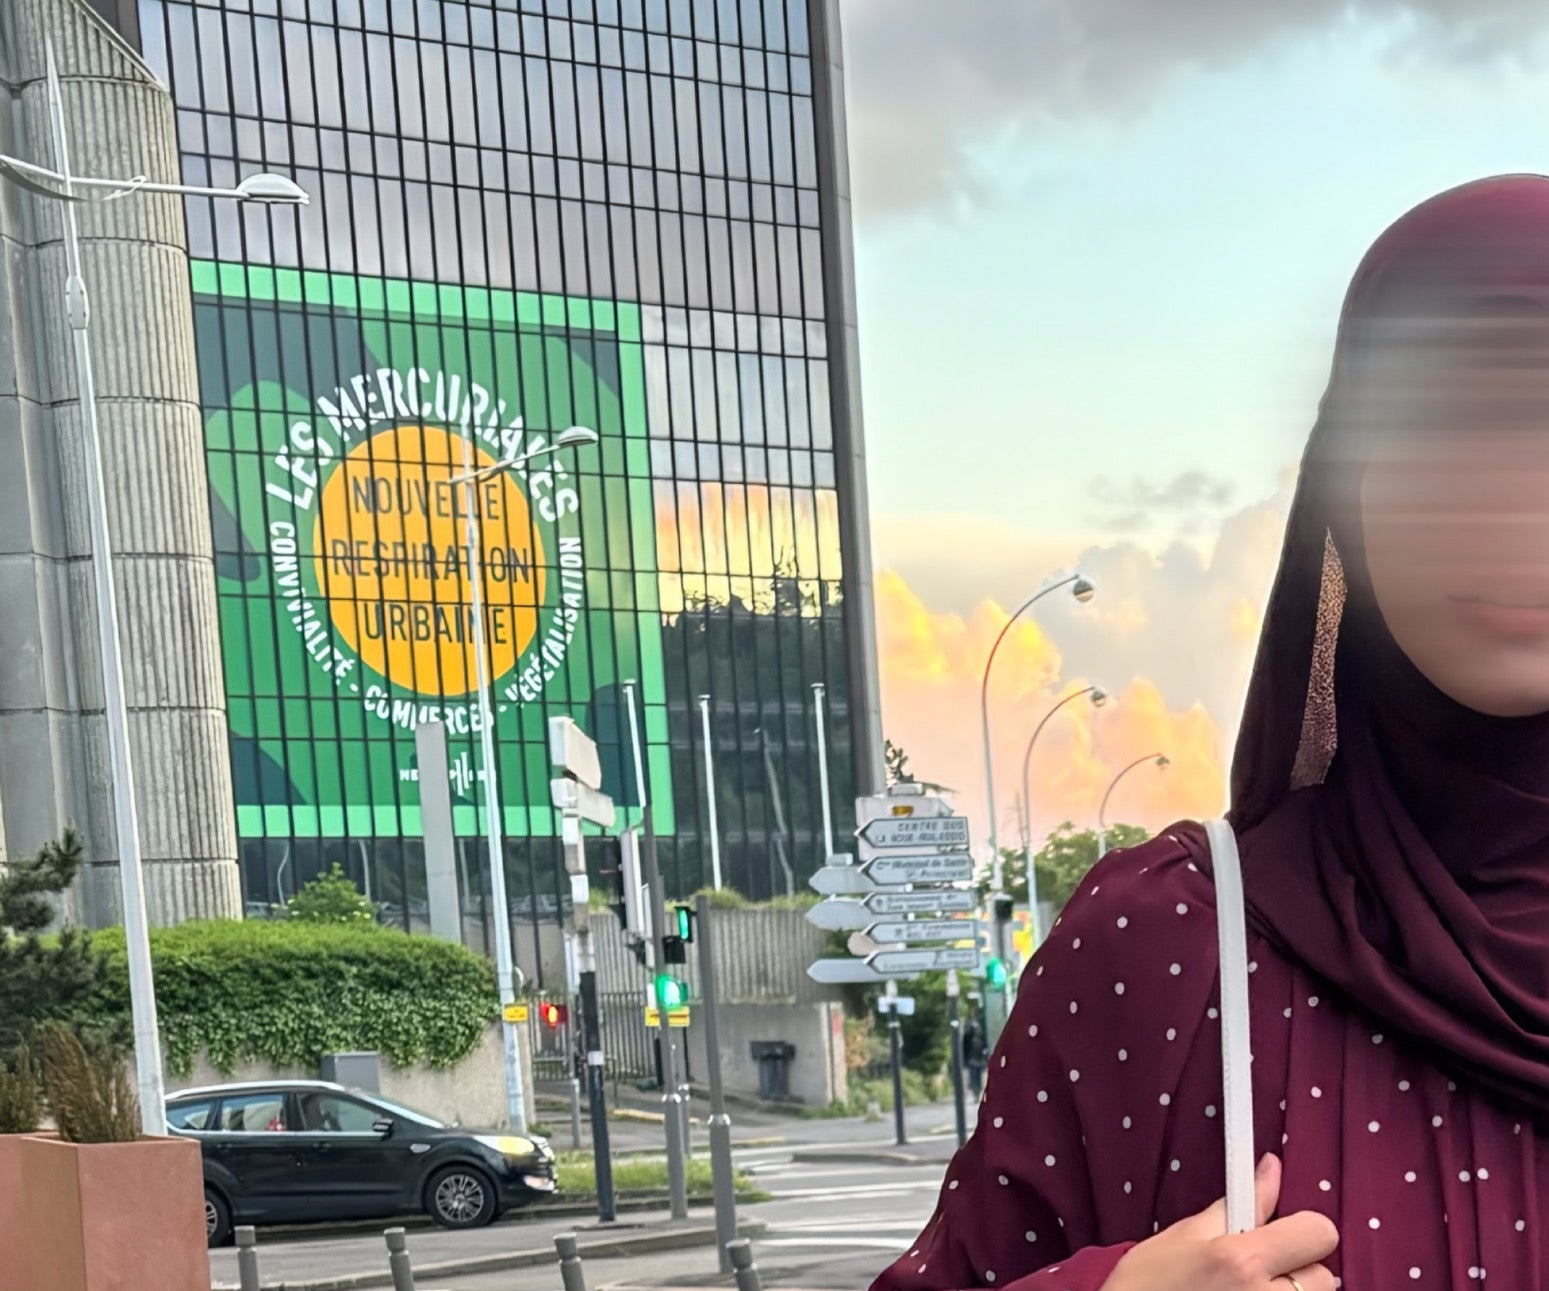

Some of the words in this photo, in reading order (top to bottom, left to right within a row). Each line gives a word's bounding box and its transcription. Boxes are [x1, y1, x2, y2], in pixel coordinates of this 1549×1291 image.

[266, 421, 334, 510] LES
[317, 367, 579, 522] MERCURIALES
[270, 521, 355, 686] CONVIVIALITÉ
[505, 537, 584, 708] VÉGÉTALISATION
[332, 539, 529, 584] RESPIRATON
